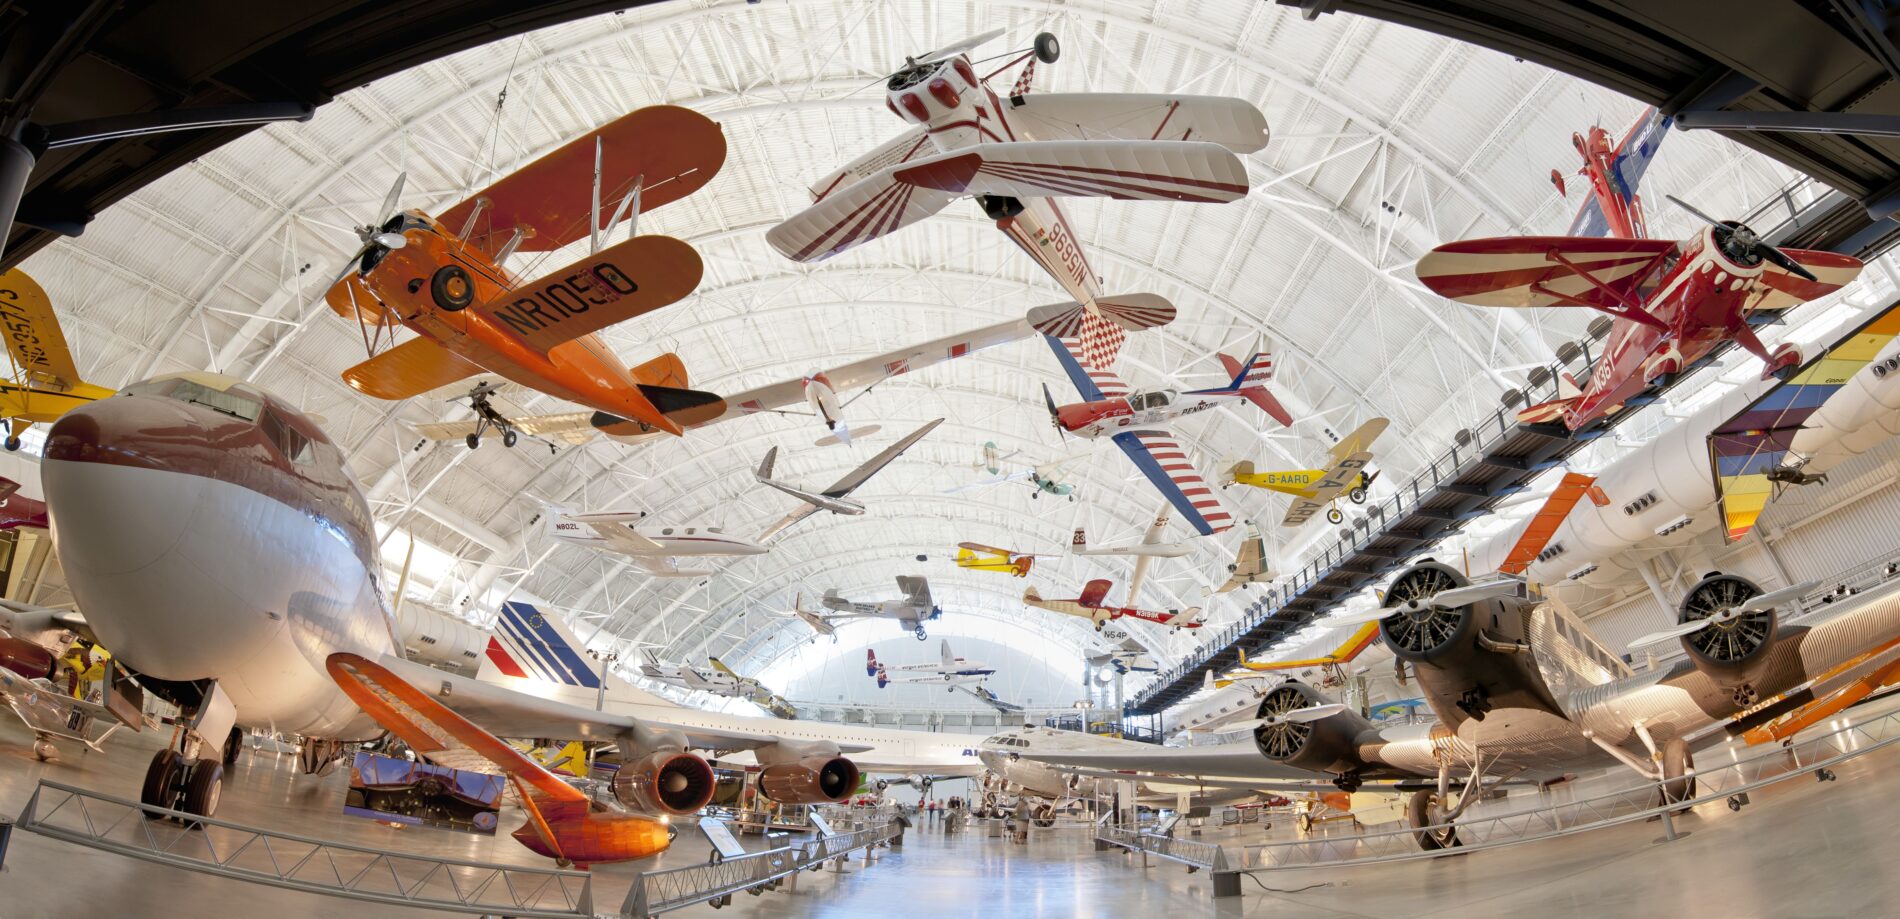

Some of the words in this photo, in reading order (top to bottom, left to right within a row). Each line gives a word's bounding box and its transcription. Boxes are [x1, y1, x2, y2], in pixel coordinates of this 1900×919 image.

[1048, 222, 1087, 287] N15696
[1593, 350, 1616, 394] N36Y
[1268, 474, 1309, 484] G-AARO
[1073, 532, 1086, 543] 33
[1104, 630, 1127, 639] N54P
